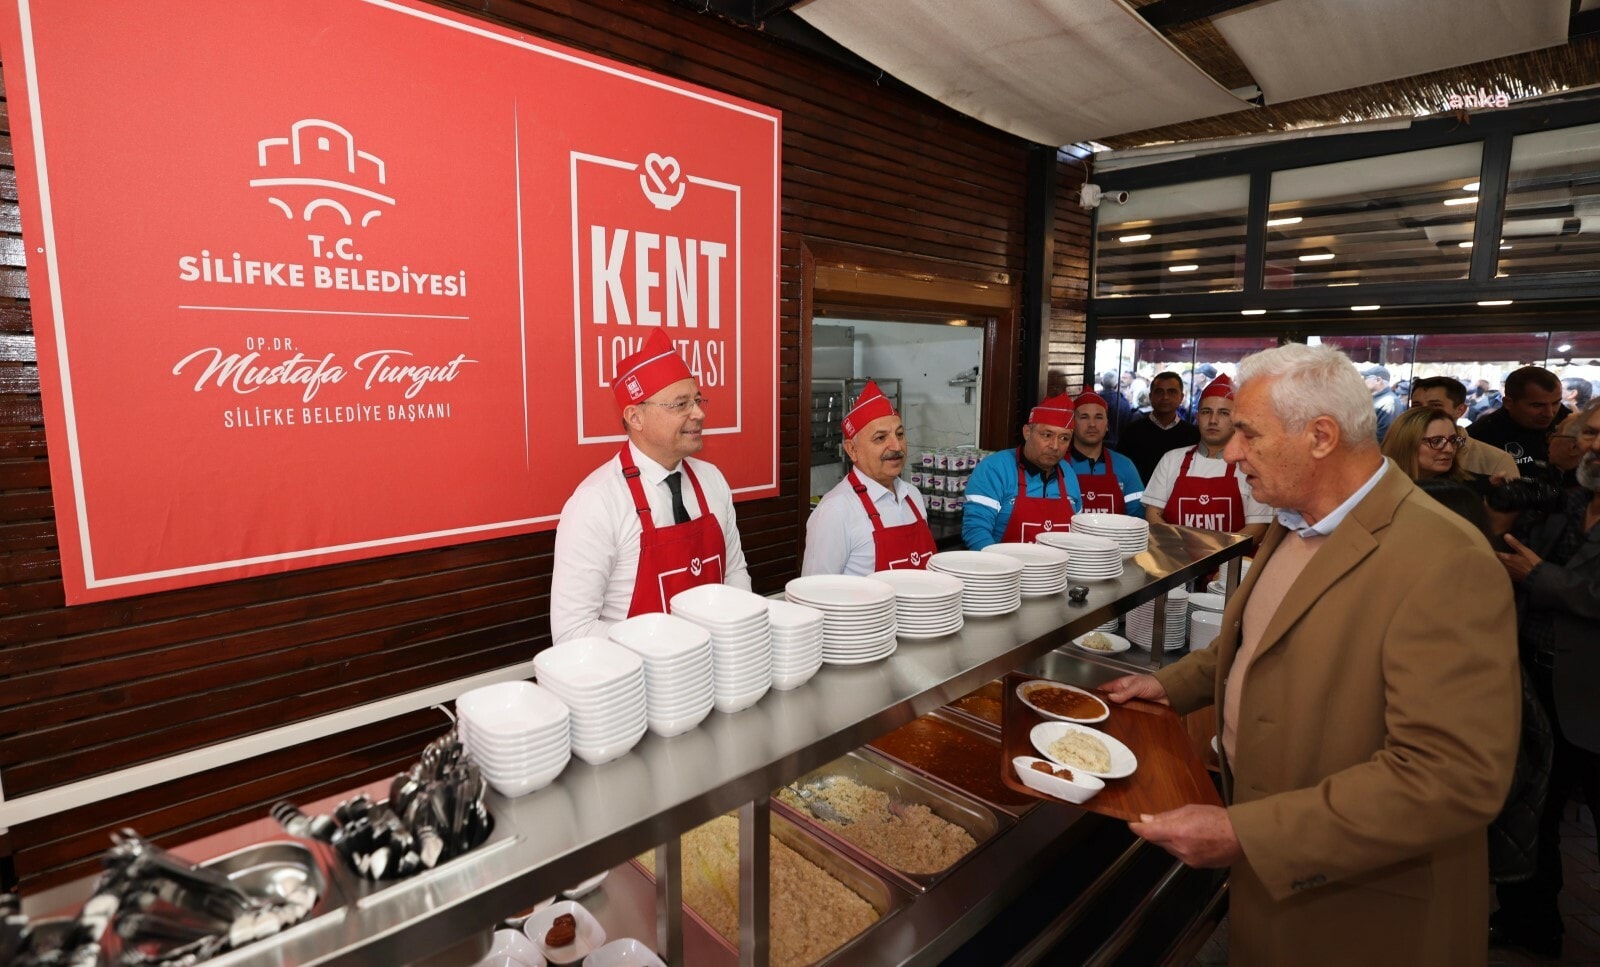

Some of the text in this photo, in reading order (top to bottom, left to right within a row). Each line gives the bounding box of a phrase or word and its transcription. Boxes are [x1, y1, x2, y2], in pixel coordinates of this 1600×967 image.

[307, 234, 364, 262] T.C.
[178, 249, 467, 297] SİLİFKE BELEDİYESİ
[590, 225, 727, 329] KENT
[246, 336, 299, 351] OP.DR.
[172, 347, 479, 403] Mustafa Turgut
[223, 402, 451, 428] SİLİFKE BELEDİYE BAŞKANI
